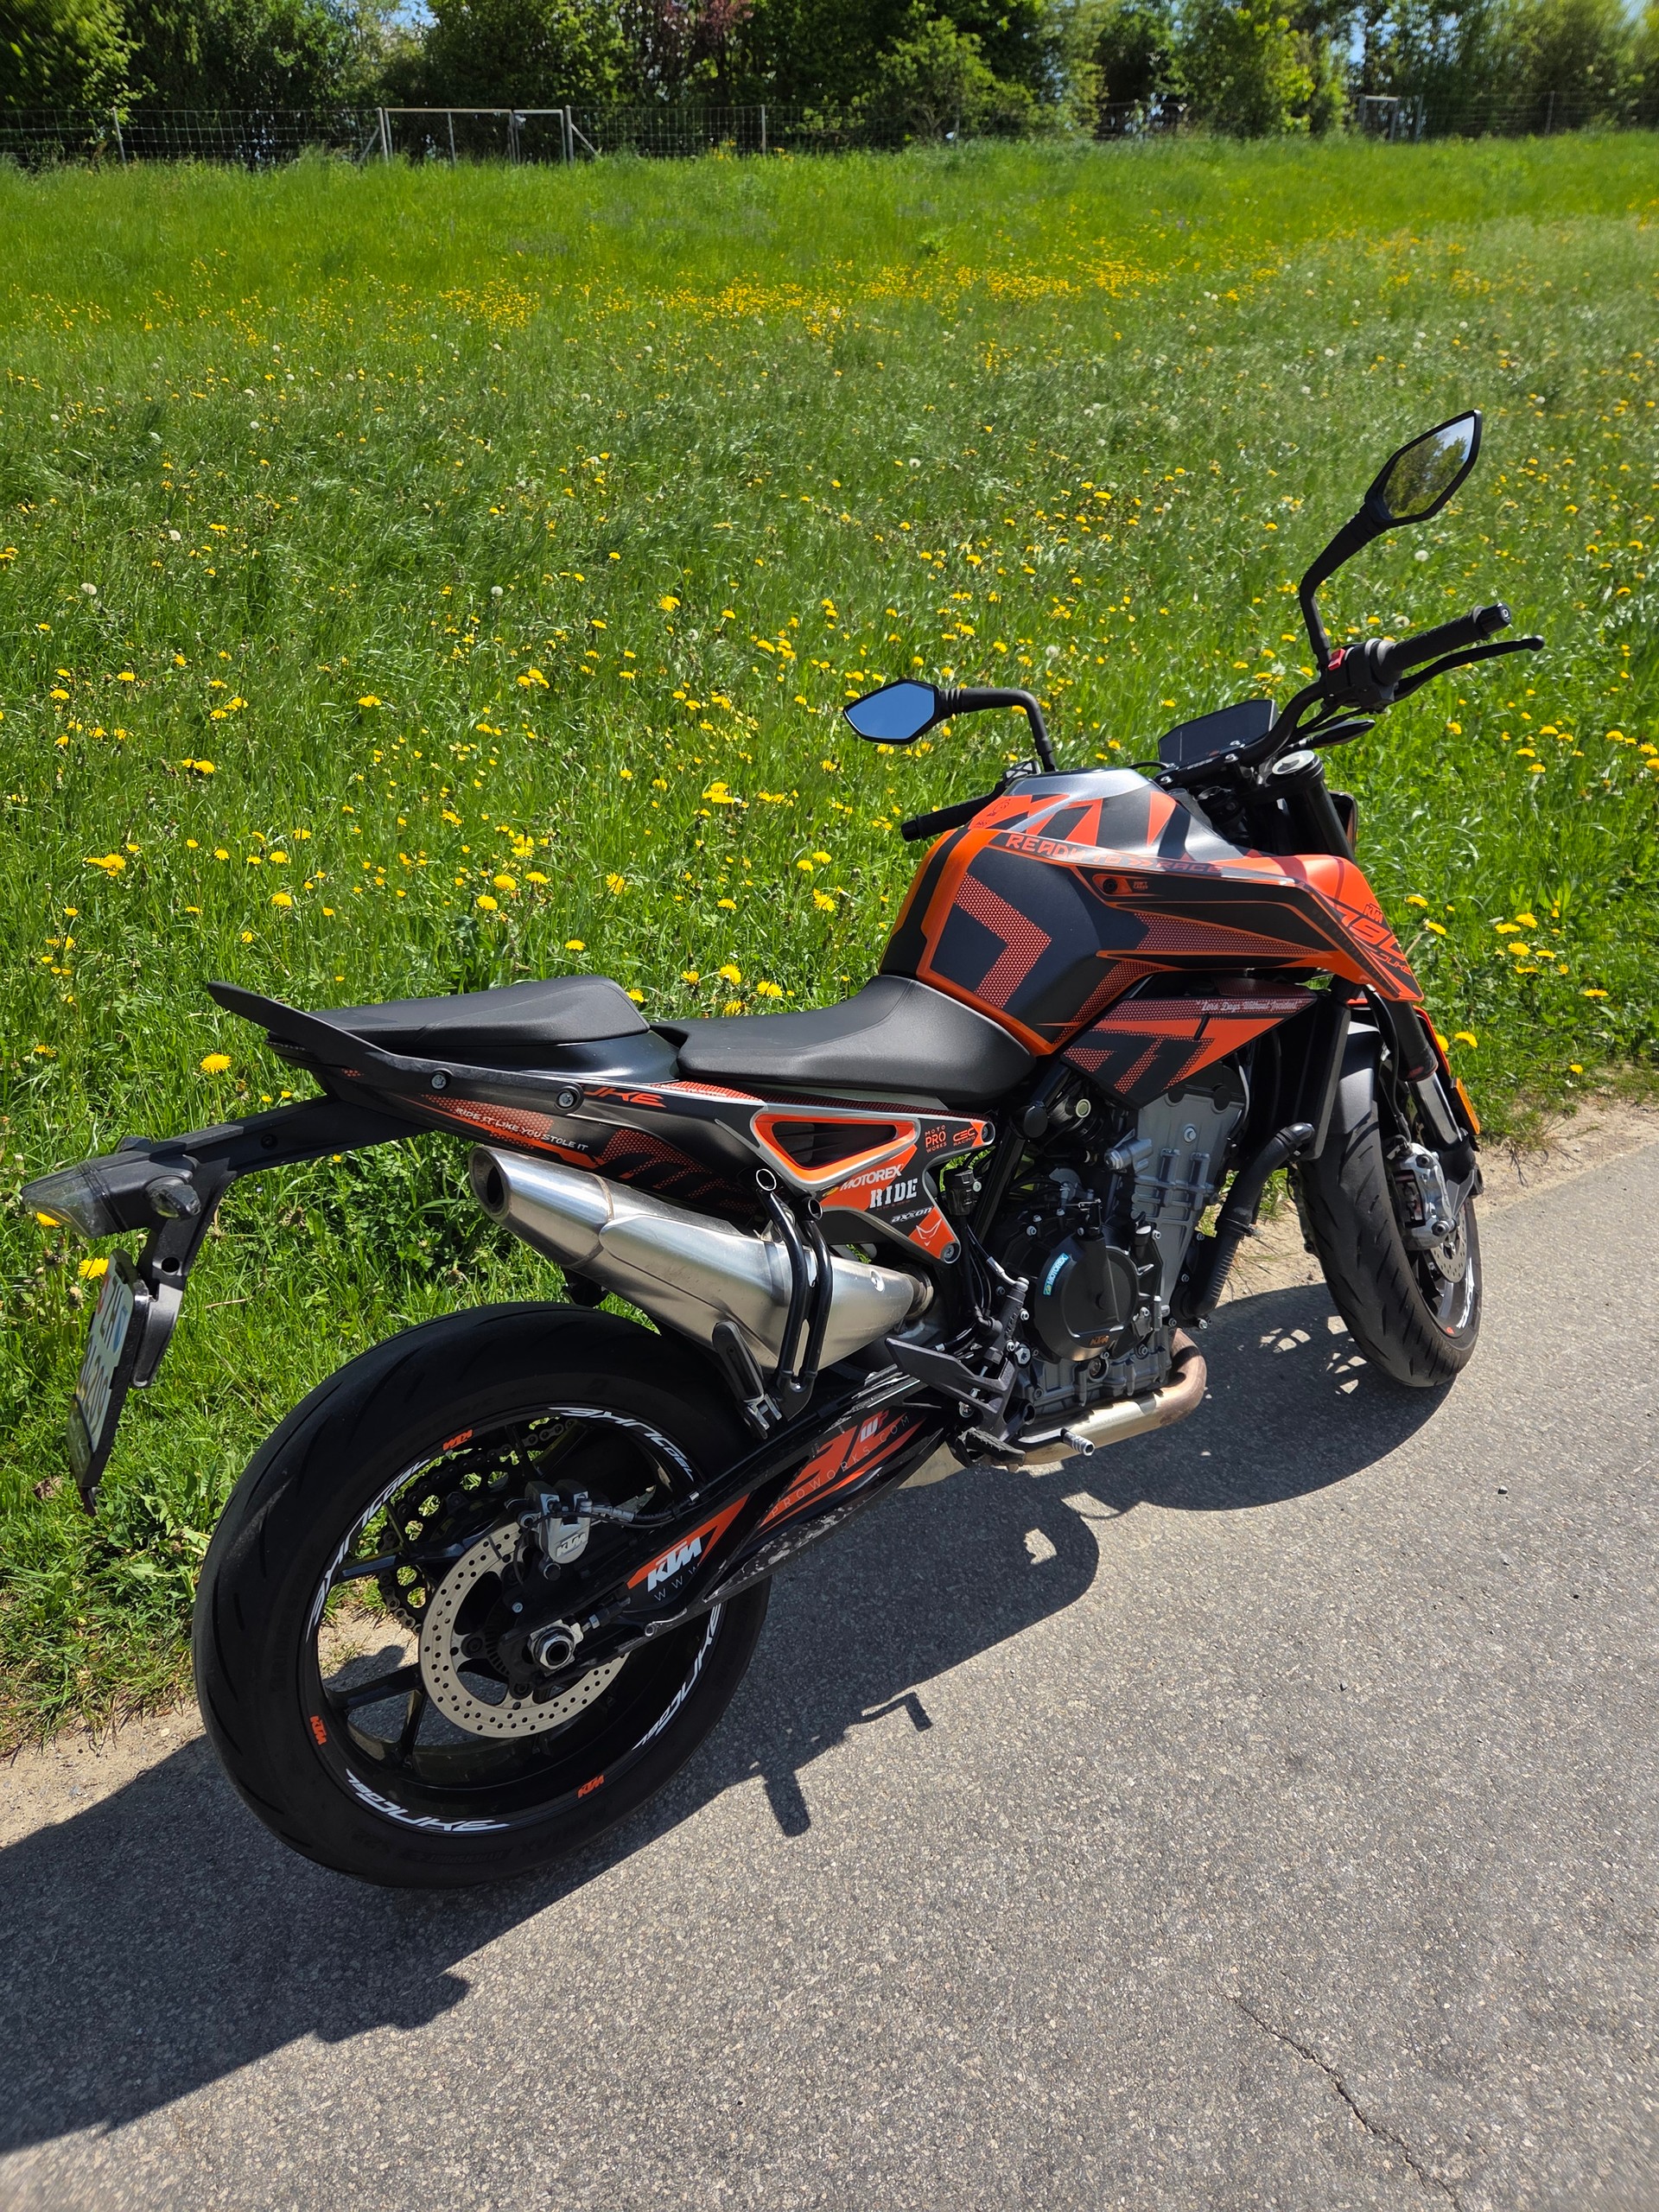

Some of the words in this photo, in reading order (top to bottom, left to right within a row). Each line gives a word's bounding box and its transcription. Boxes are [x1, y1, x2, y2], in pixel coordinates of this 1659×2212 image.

[1005, 833, 1085, 861] READY
[1093, 854, 1122, 864] TO
[1156, 861, 1224, 874] RACE
[1363, 903, 1382, 924] KTM
[455, 1107, 481, 1121] RIDE
[495, 1118, 519, 1132] LIKE
[518, 1126, 543, 1138] YOU
[542, 1133, 577, 1149] STOLE
[577, 1142, 589, 1151] IT
[925, 1124, 946, 1137] MOTO
[925, 1130, 946, 1148] PRO
[953, 1135, 976, 1147] RACING
[926, 1141, 948, 1154] WORKS
[839, 1164, 902, 1192] MOTOREX
[869, 1178, 918, 1209] RIDE
[1046, 1255, 1068, 1286] MOTOREX
[442, 1428, 474, 1452] KTM
[556, 1532, 588, 1557] KTM
[648, 1536, 702, 1592] KTM
[309, 1715, 327, 1745] KTM
[577, 1774, 604, 1799] KTM
